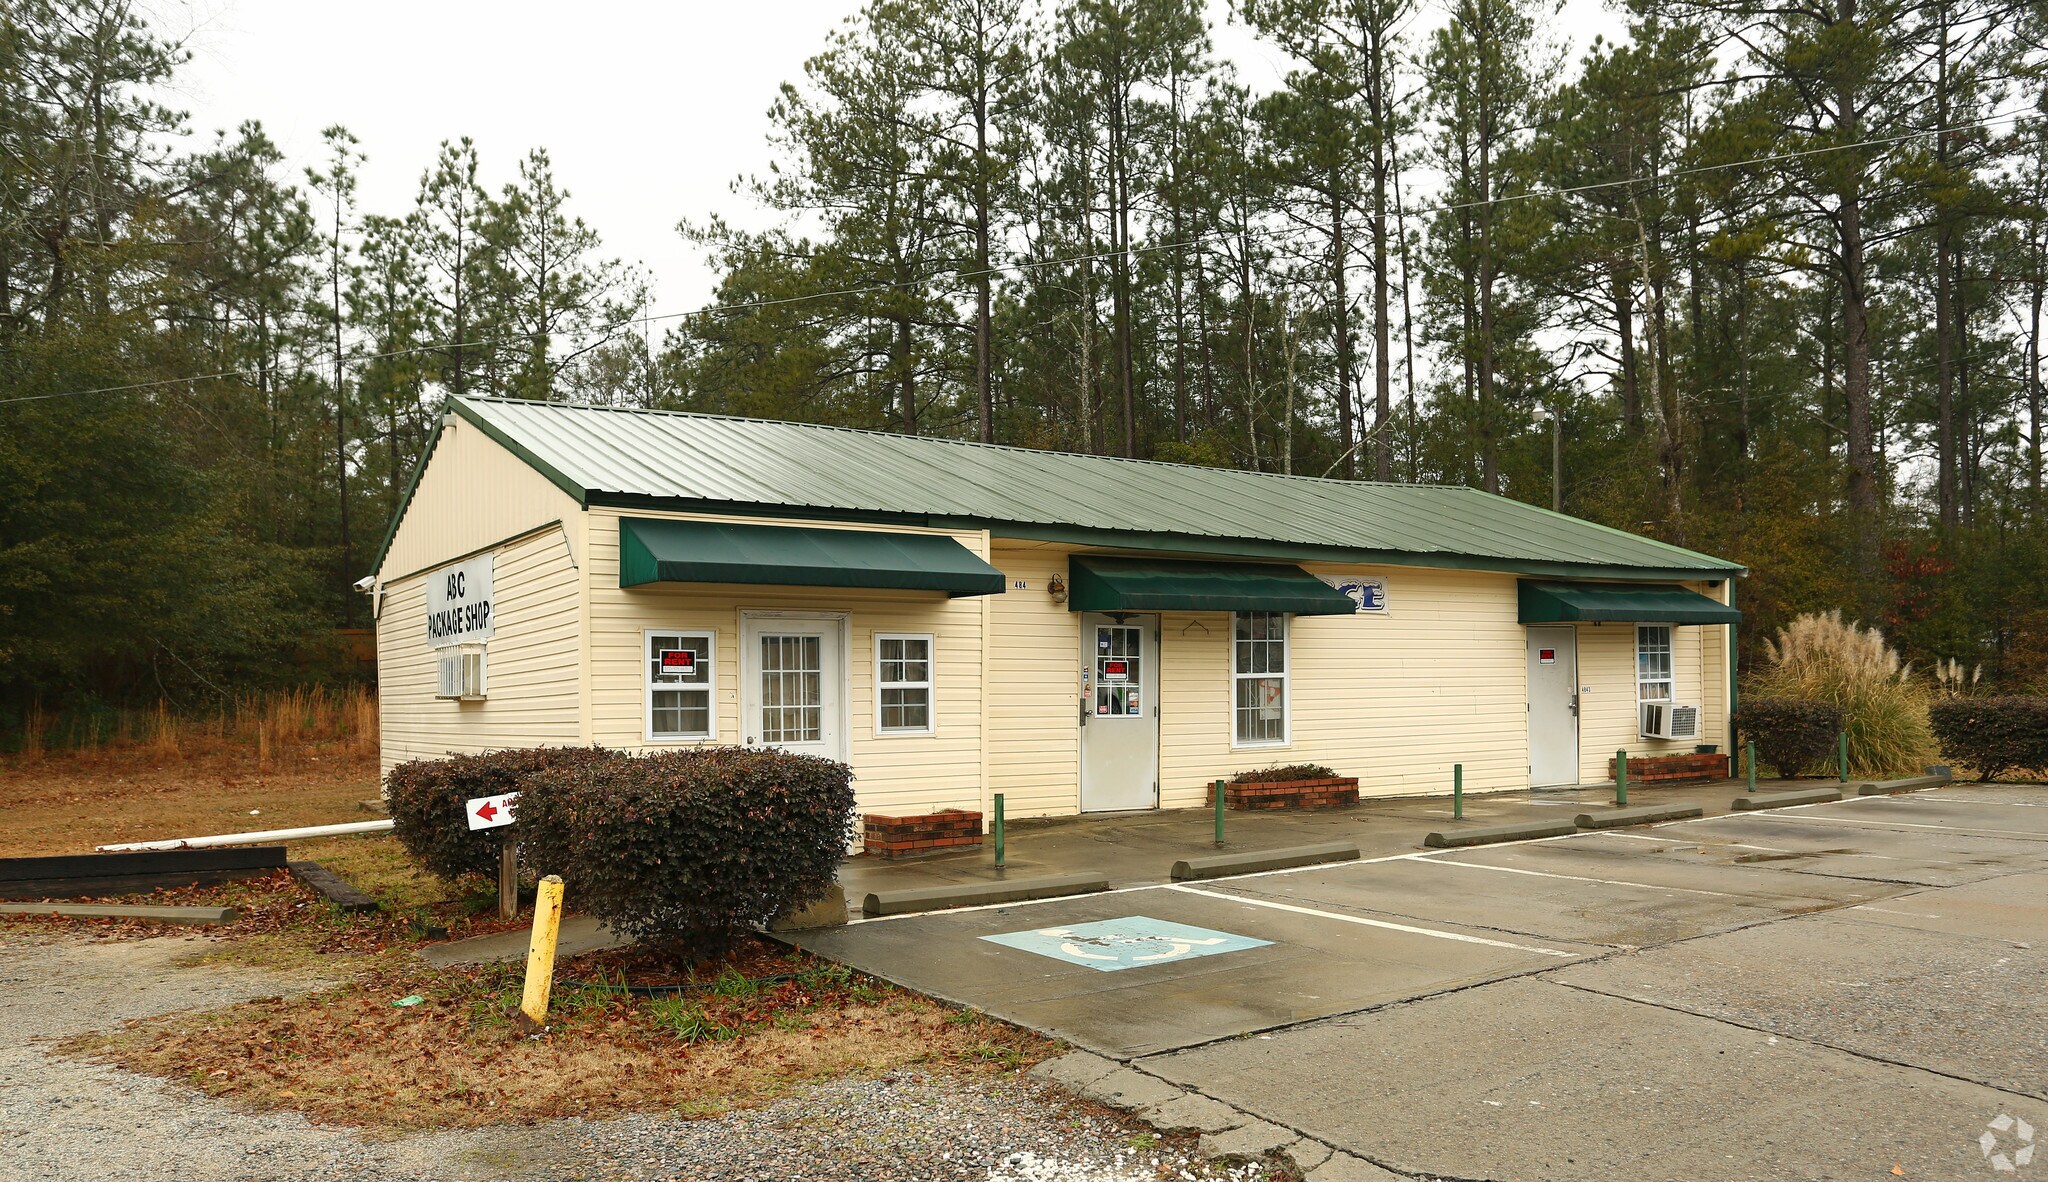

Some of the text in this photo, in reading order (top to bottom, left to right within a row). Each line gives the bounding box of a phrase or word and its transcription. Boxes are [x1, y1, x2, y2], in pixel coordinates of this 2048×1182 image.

[446, 571, 465, 601] ABC
[1014, 580, 1026, 589] 484
[428, 600, 490, 639] PACKAGE SHOP
